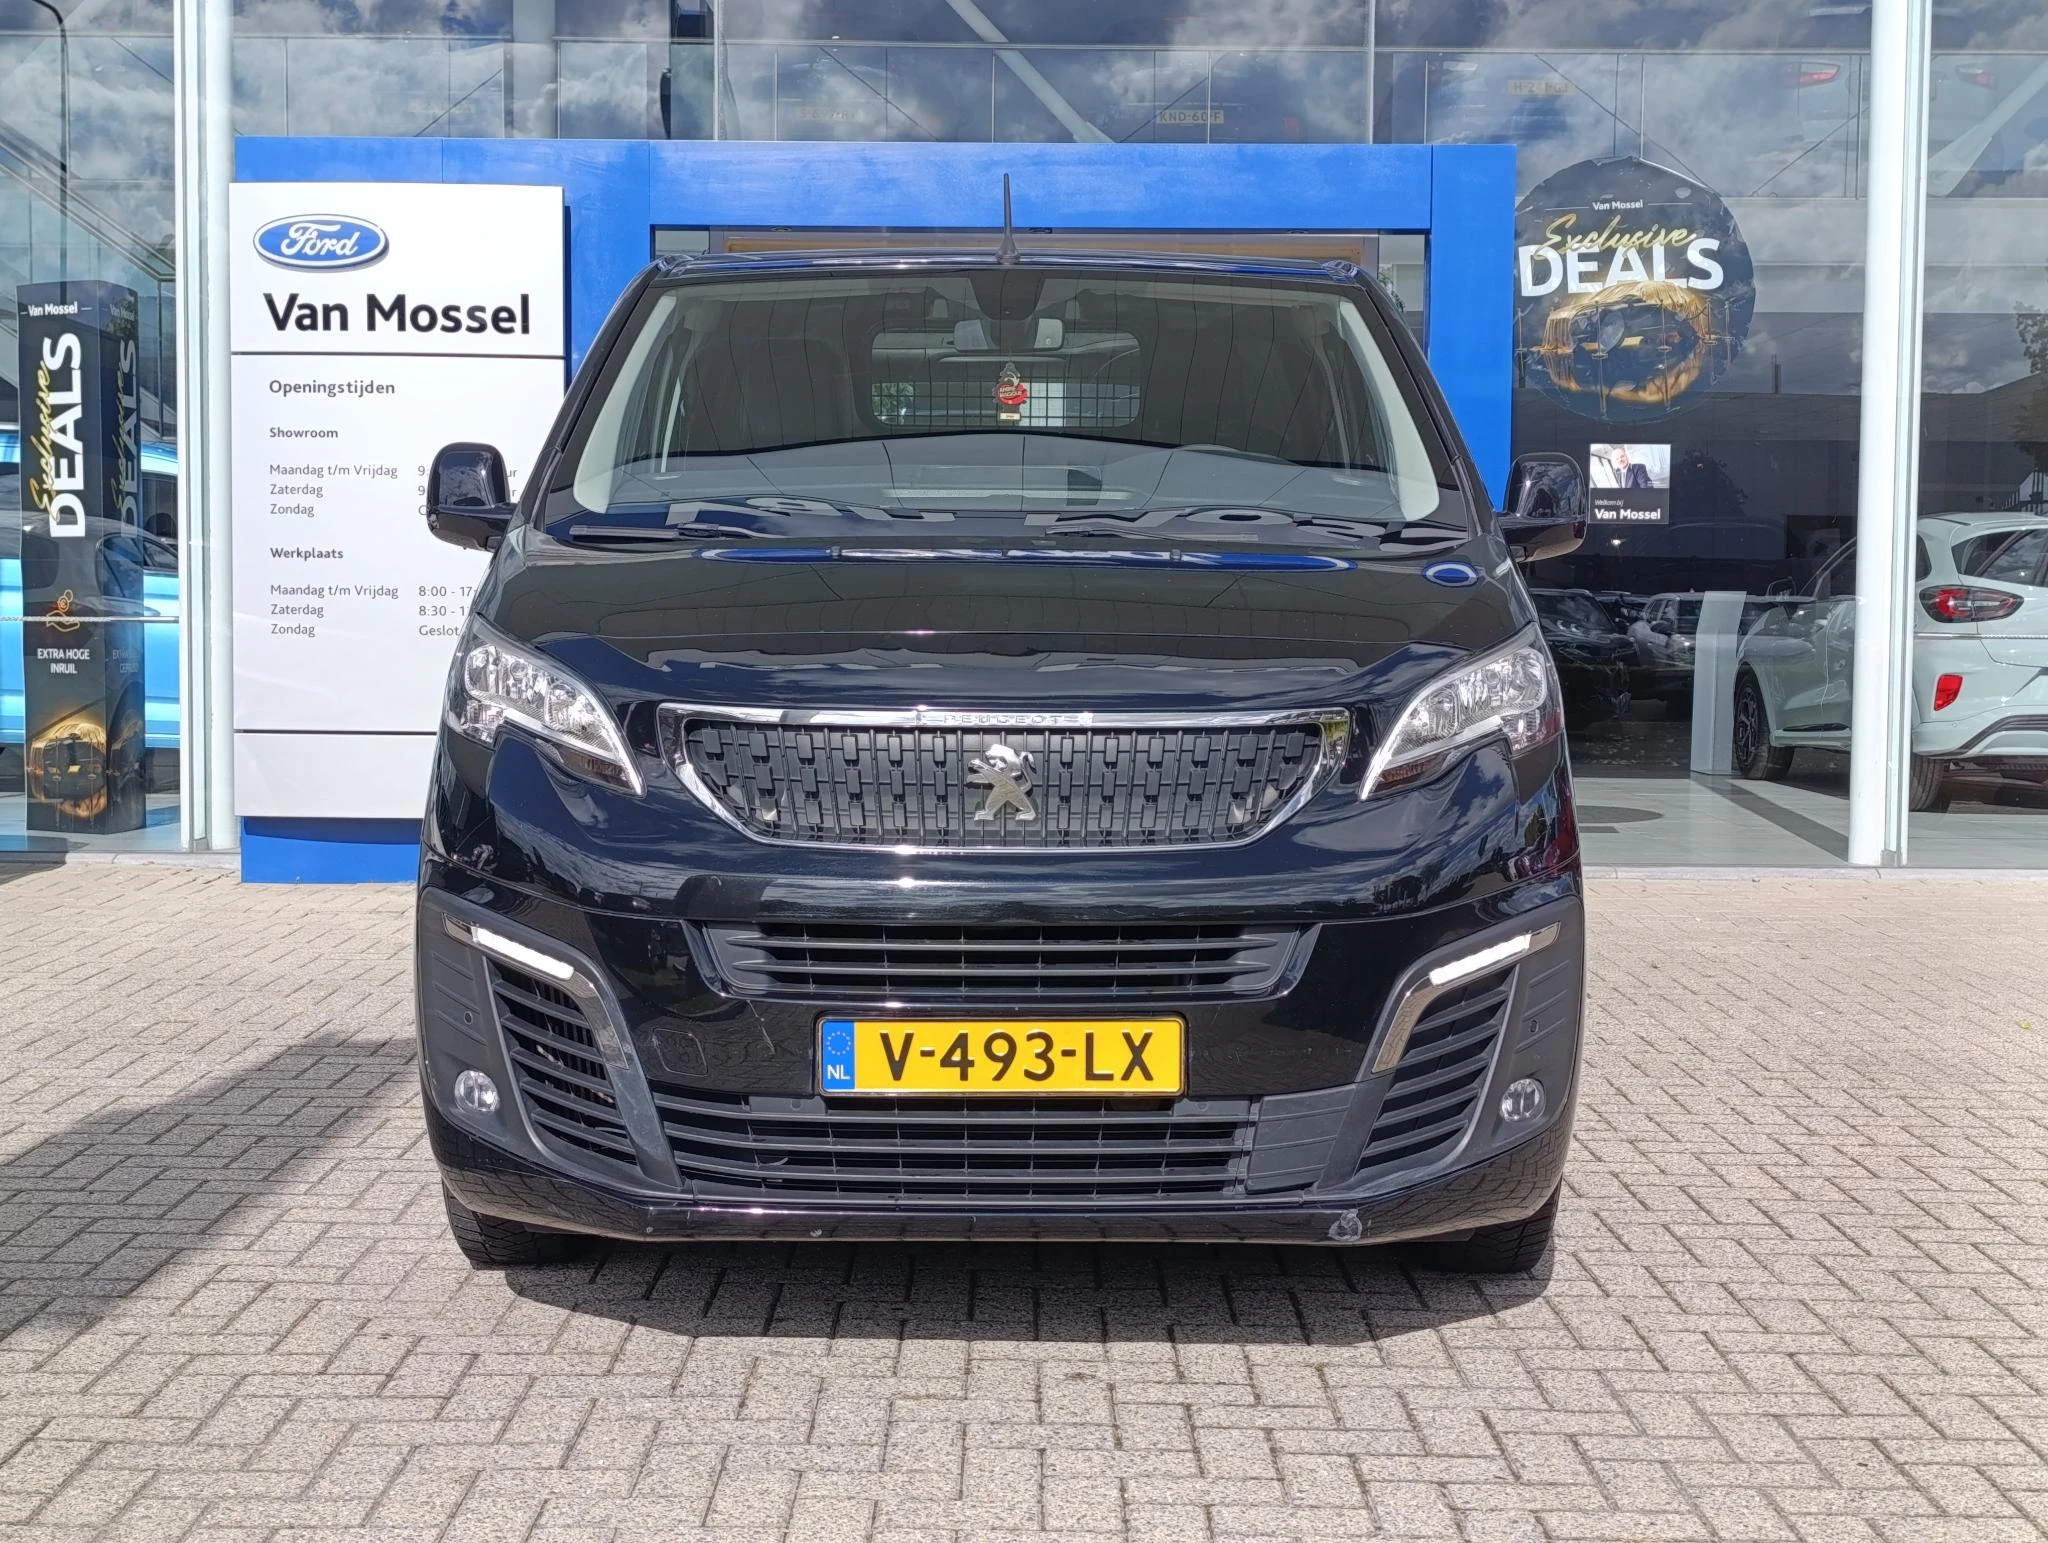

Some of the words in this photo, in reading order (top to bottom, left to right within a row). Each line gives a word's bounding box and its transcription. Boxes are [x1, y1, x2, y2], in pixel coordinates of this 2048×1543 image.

[1592, 201, 1610, 211] Van
[1612, 199, 1644, 209] Mossel
[280, 222, 361, 256] Ford
[1533, 213, 1699, 261] Exclusive
[1518, 238, 1724, 297] DEALS
[28, 303, 43, 317] Van
[44, 301, 78, 315] Mossel
[262, 292, 349, 332] Van
[366, 293, 530, 335] Mossel
[269, 379, 396, 398] Openingstijden
[42, 333, 86, 538] DEALS
[269, 427, 339, 439] Showroom
[28, 360, 59, 524] Exclusive
[269, 464, 325, 479] Maandag
[327, 464, 350, 477] t/m
[353, 464, 398, 480] Vrijdag
[270, 484, 324, 498] Zaterdag
[270, 504, 315, 518] Zondag
[1594, 508, 1617, 520] Van
[1619, 508, 1661, 520] Mossel
[270, 547, 344, 562] Werkplaats
[270, 585, 325, 599] Maandag
[328, 585, 351, 597] t/m
[354, 585, 399, 600] Vrijdag
[418, 585, 447, 597] 8:00
[270, 604, 325, 618] Zaterdag
[418, 605, 447, 617] 8:30
[270, 623, 316, 638] Zondag
[418, 624, 460, 637] Geslot
[37, 648, 64, 660] EXTRA
[65, 648, 90, 660] HOGE
[50, 663, 78, 674] INRUIL
[943, 713, 1065, 725] PEUGEOT
[879, 1030, 1154, 1082] V-493-LX
[826, 1064, 851, 1081] NL
